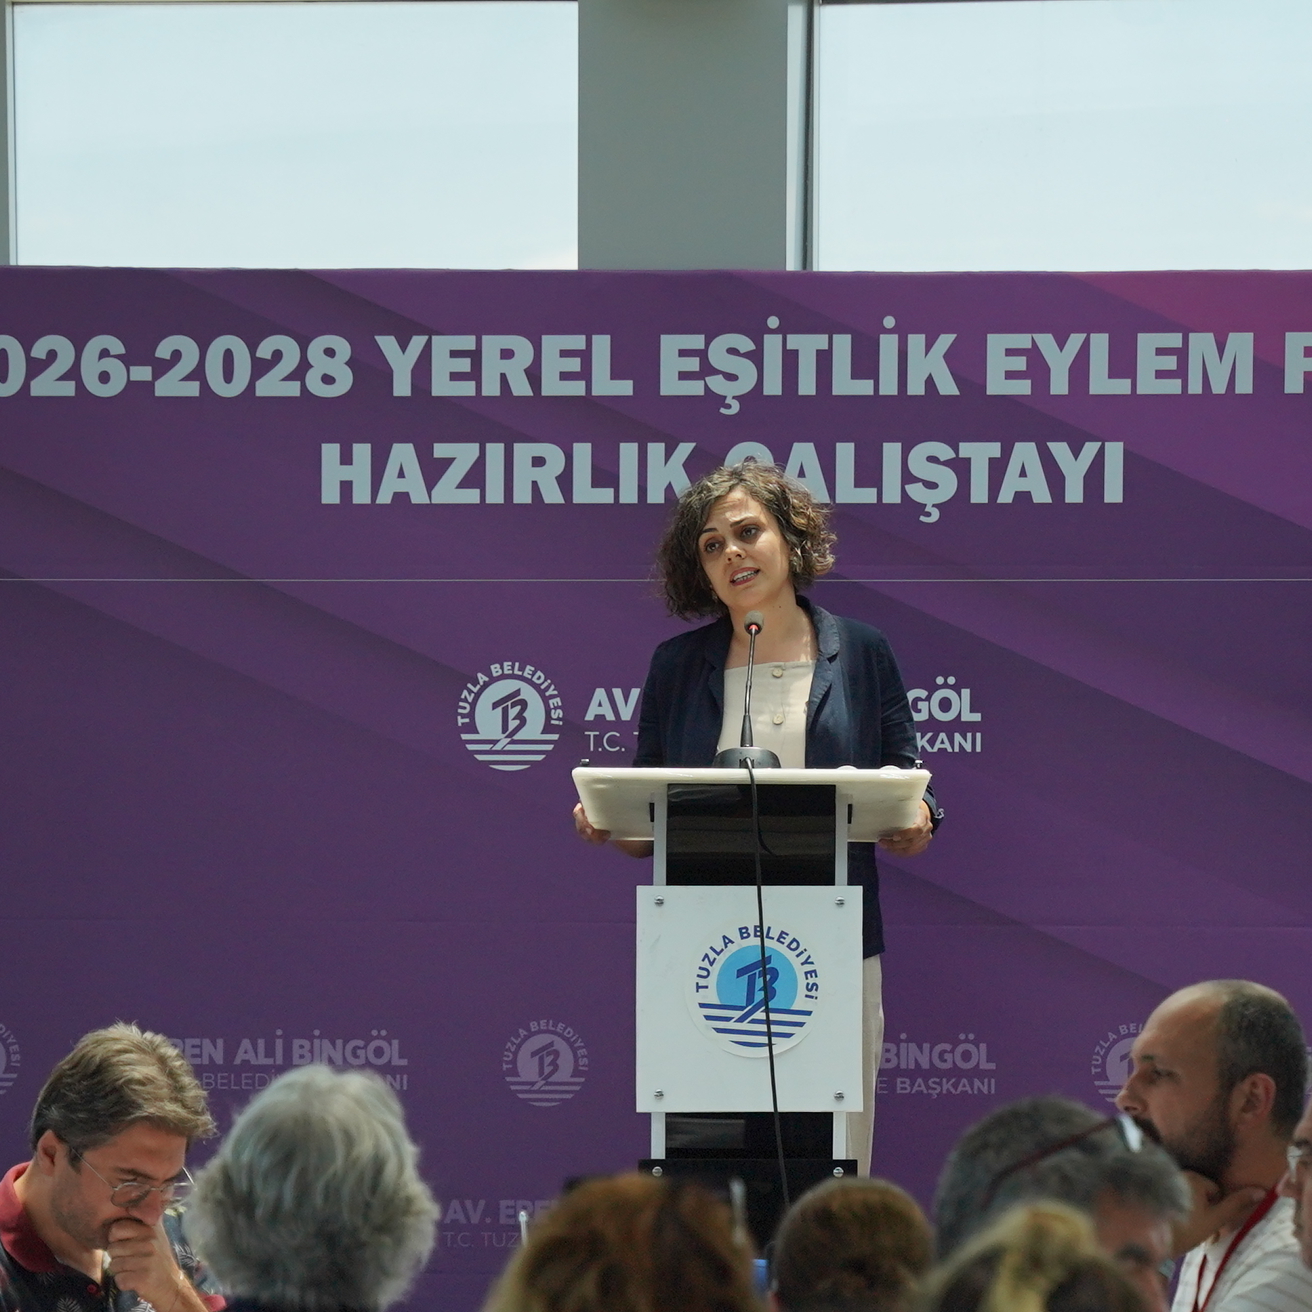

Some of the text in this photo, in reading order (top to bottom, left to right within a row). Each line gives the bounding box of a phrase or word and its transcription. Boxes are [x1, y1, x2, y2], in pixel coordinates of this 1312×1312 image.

[374, 334, 634, 397] YEREL
[660, 315, 960, 415] EŞİTLİK
[985, 331, 1254, 395] EYLEM
[320, 441, 697, 505] HAZIRLIK
[457, 672, 490, 727] TUZLA
[906, 675, 982, 722] GÖL
[584, 731, 626, 752] T.C.
[915, 731, 982, 753] KANI
[696, 934, 736, 993] TUZLA
[233, 1028, 284, 1065] ALİ
[292, 1028, 408, 1066] BİNGÖL
[502, 1028, 529, 1072] TUZLA
[879, 1032, 997, 1070] BİNGÖL
[1090, 1031, 1118, 1075] TUZLA
[896, 1077, 996, 1099] BAŞKANI
[481, 1231, 521, 1248] TUZ
